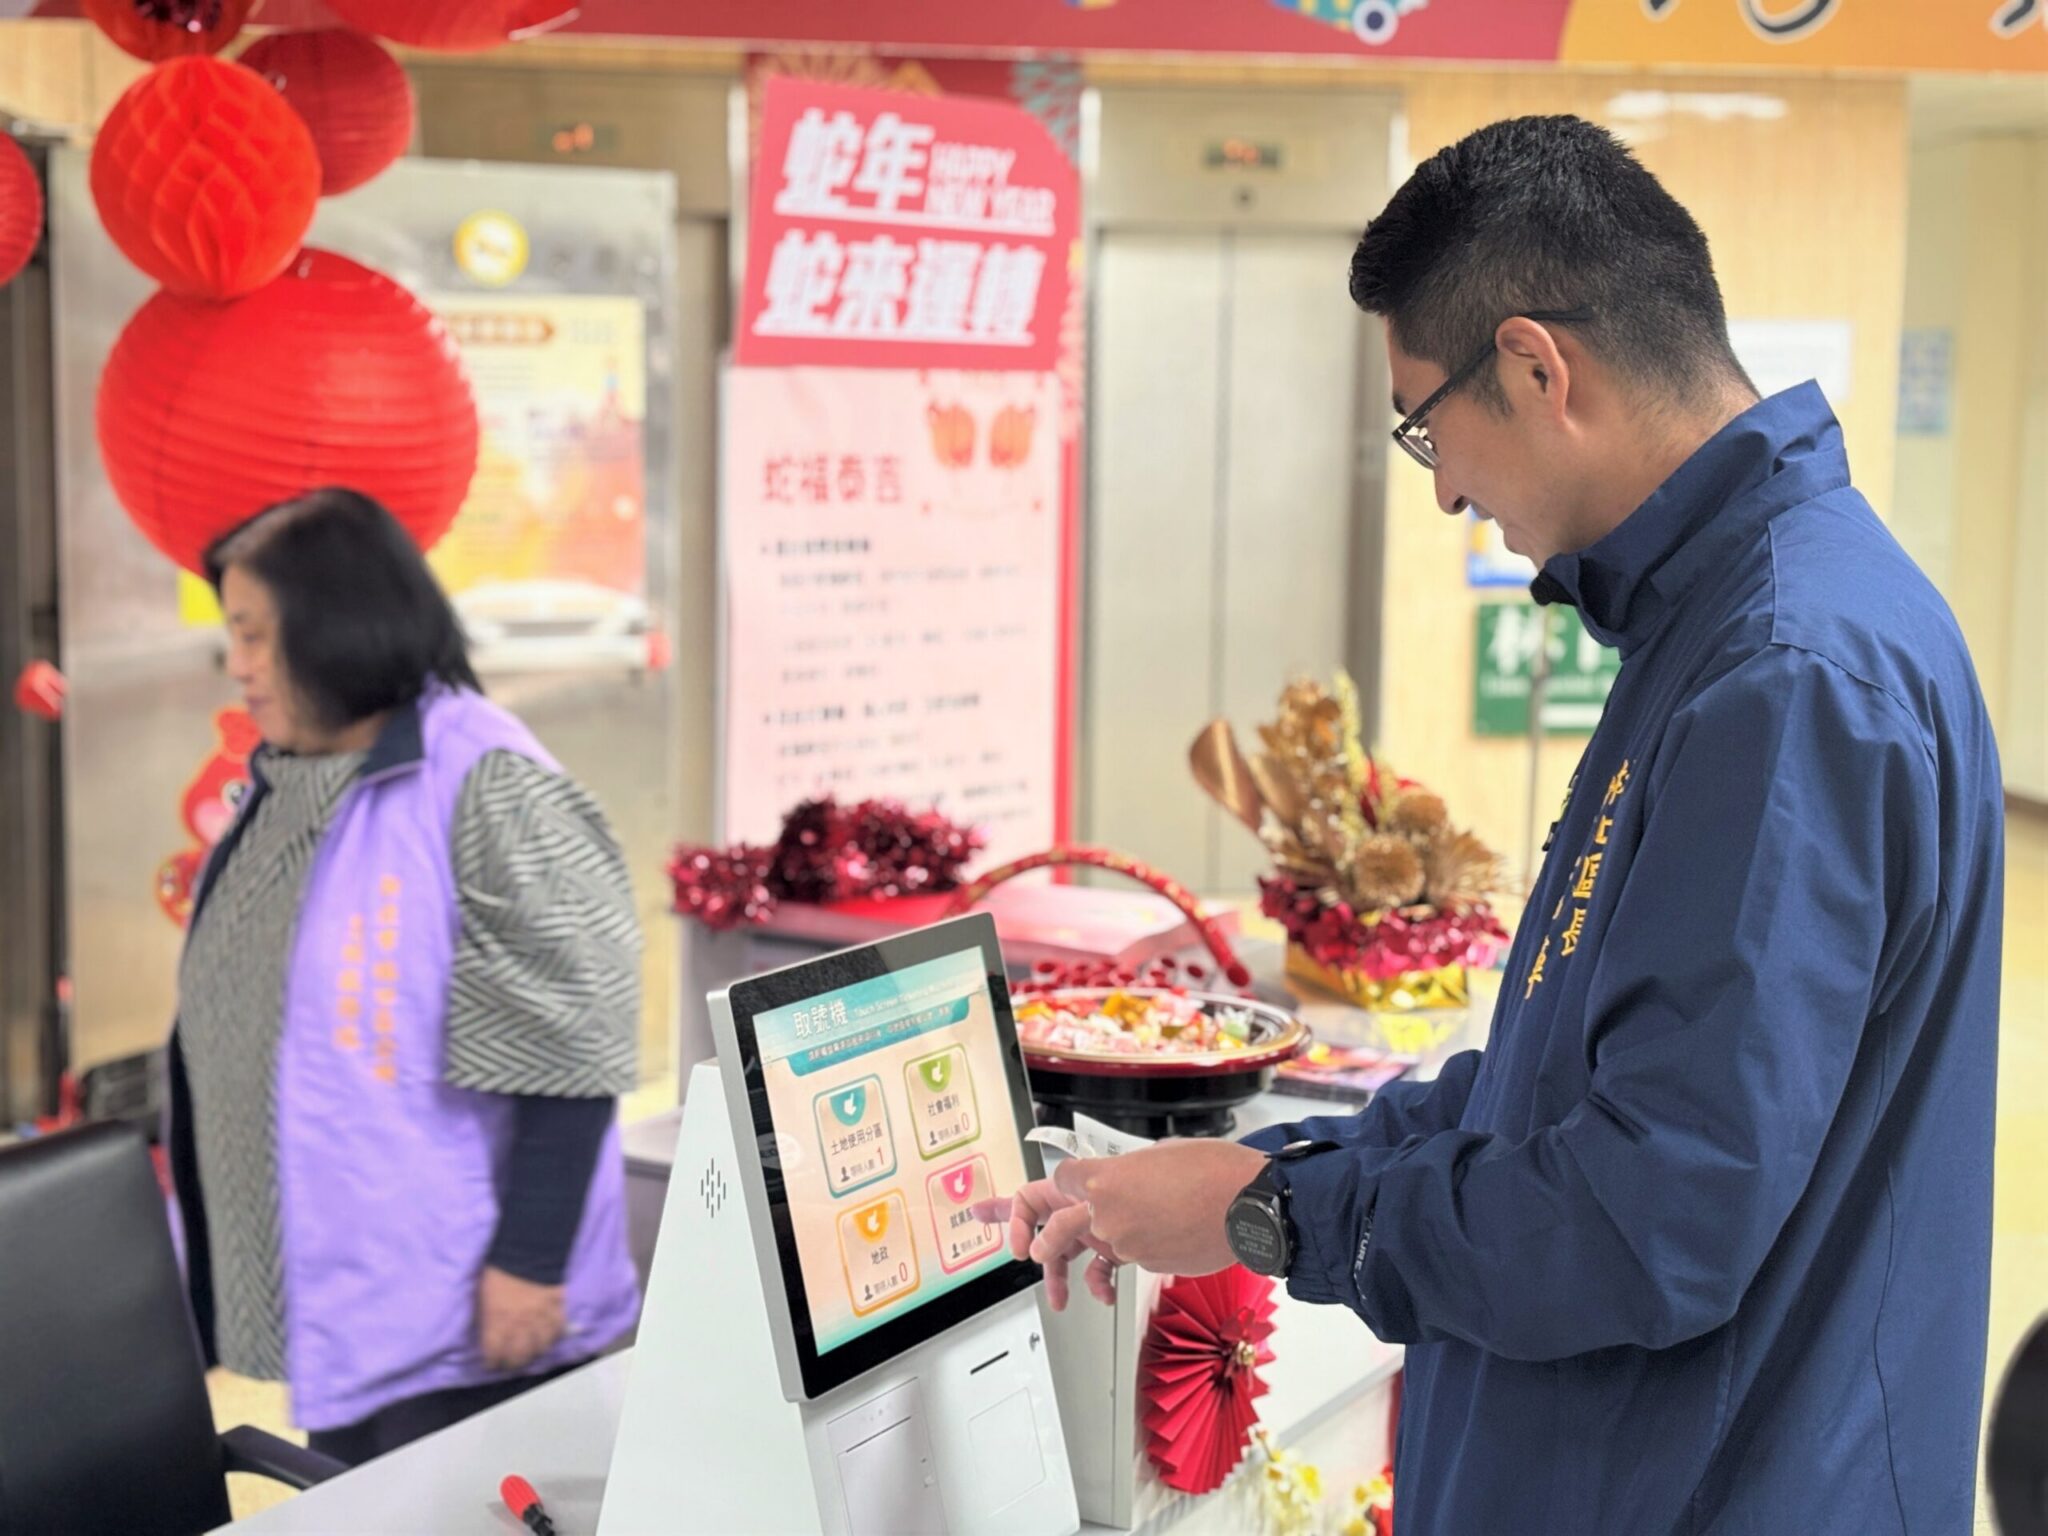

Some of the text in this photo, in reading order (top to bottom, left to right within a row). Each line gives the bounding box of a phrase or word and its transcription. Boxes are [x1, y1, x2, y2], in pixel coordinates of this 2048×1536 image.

[775, 107, 934, 214] 蛇年
[930, 142, 1016, 183] HAPPY
[923, 182, 1056, 230] NEW YEAR
[754, 229, 1046, 344] 蛇來運轉
[792, 998, 849, 1039] 取號機
[927, 1094, 961, 1117] 社會福利
[961, 1112, 970, 1131] 0
[831, 1122, 884, 1156] 土地使用分區
[877, 1147, 885, 1165] 1
[984, 1223, 992, 1242] 0
[870, 1246, 889, 1266] 地政
[899, 1262, 908, 1282] 0
